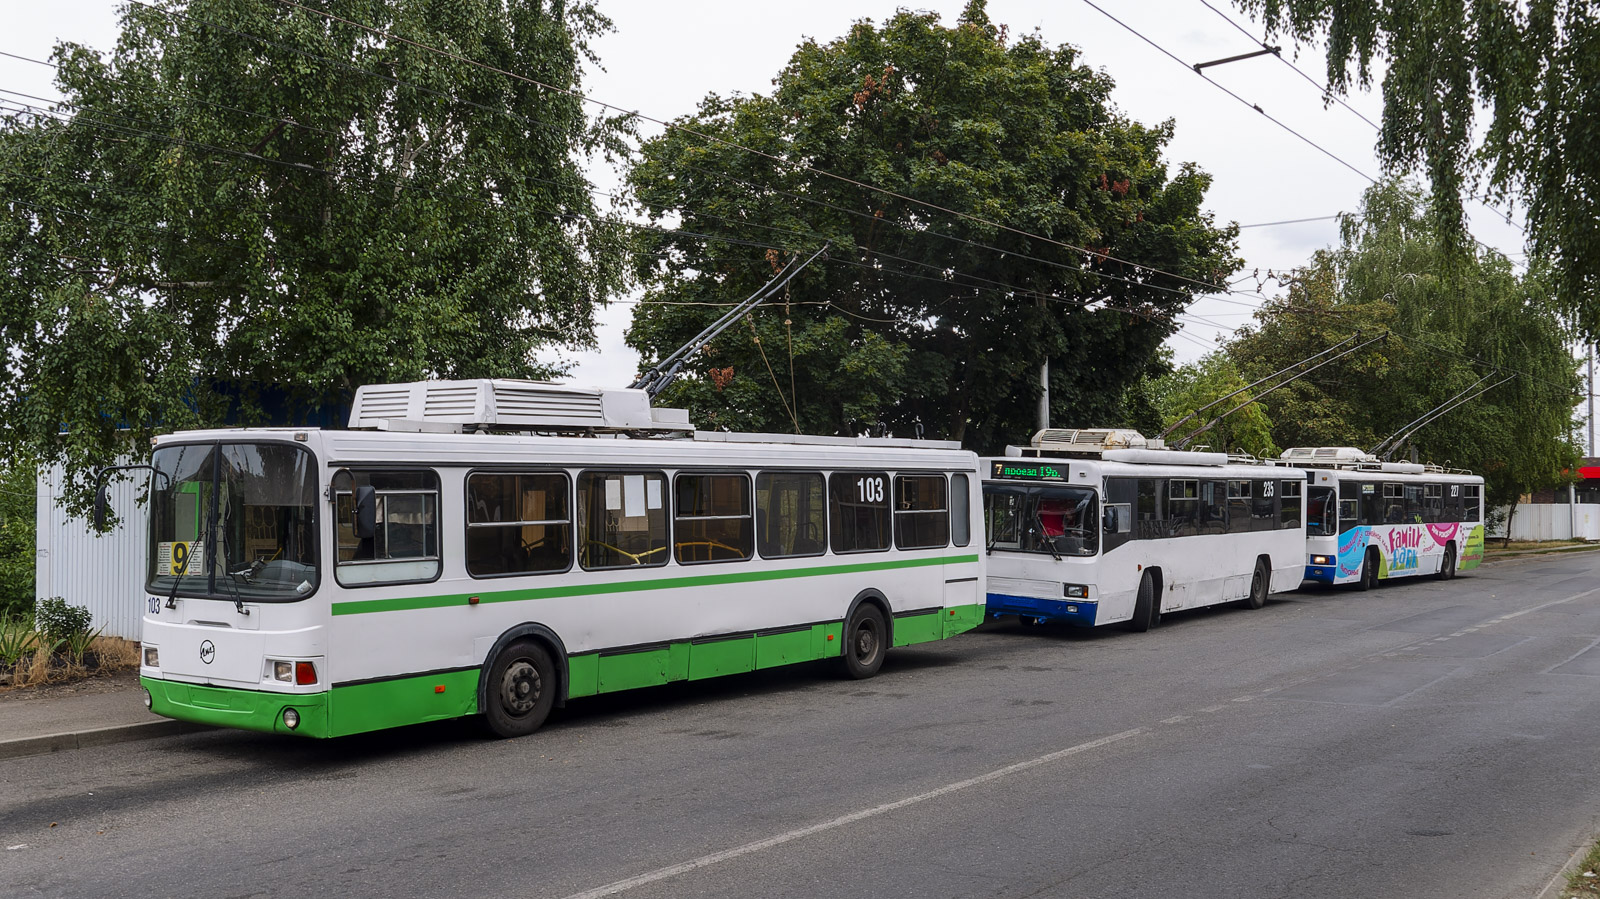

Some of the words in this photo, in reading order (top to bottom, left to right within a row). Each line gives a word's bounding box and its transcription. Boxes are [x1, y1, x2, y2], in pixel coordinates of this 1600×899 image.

[995, 463, 1003, 475] 7
[857, 477, 884, 503] 103
[1264, 481, 1274, 497] 235
[1451, 485, 1459, 497] 227
[173, 543, 187, 574] 9
[148, 597, 160, 614] 103
